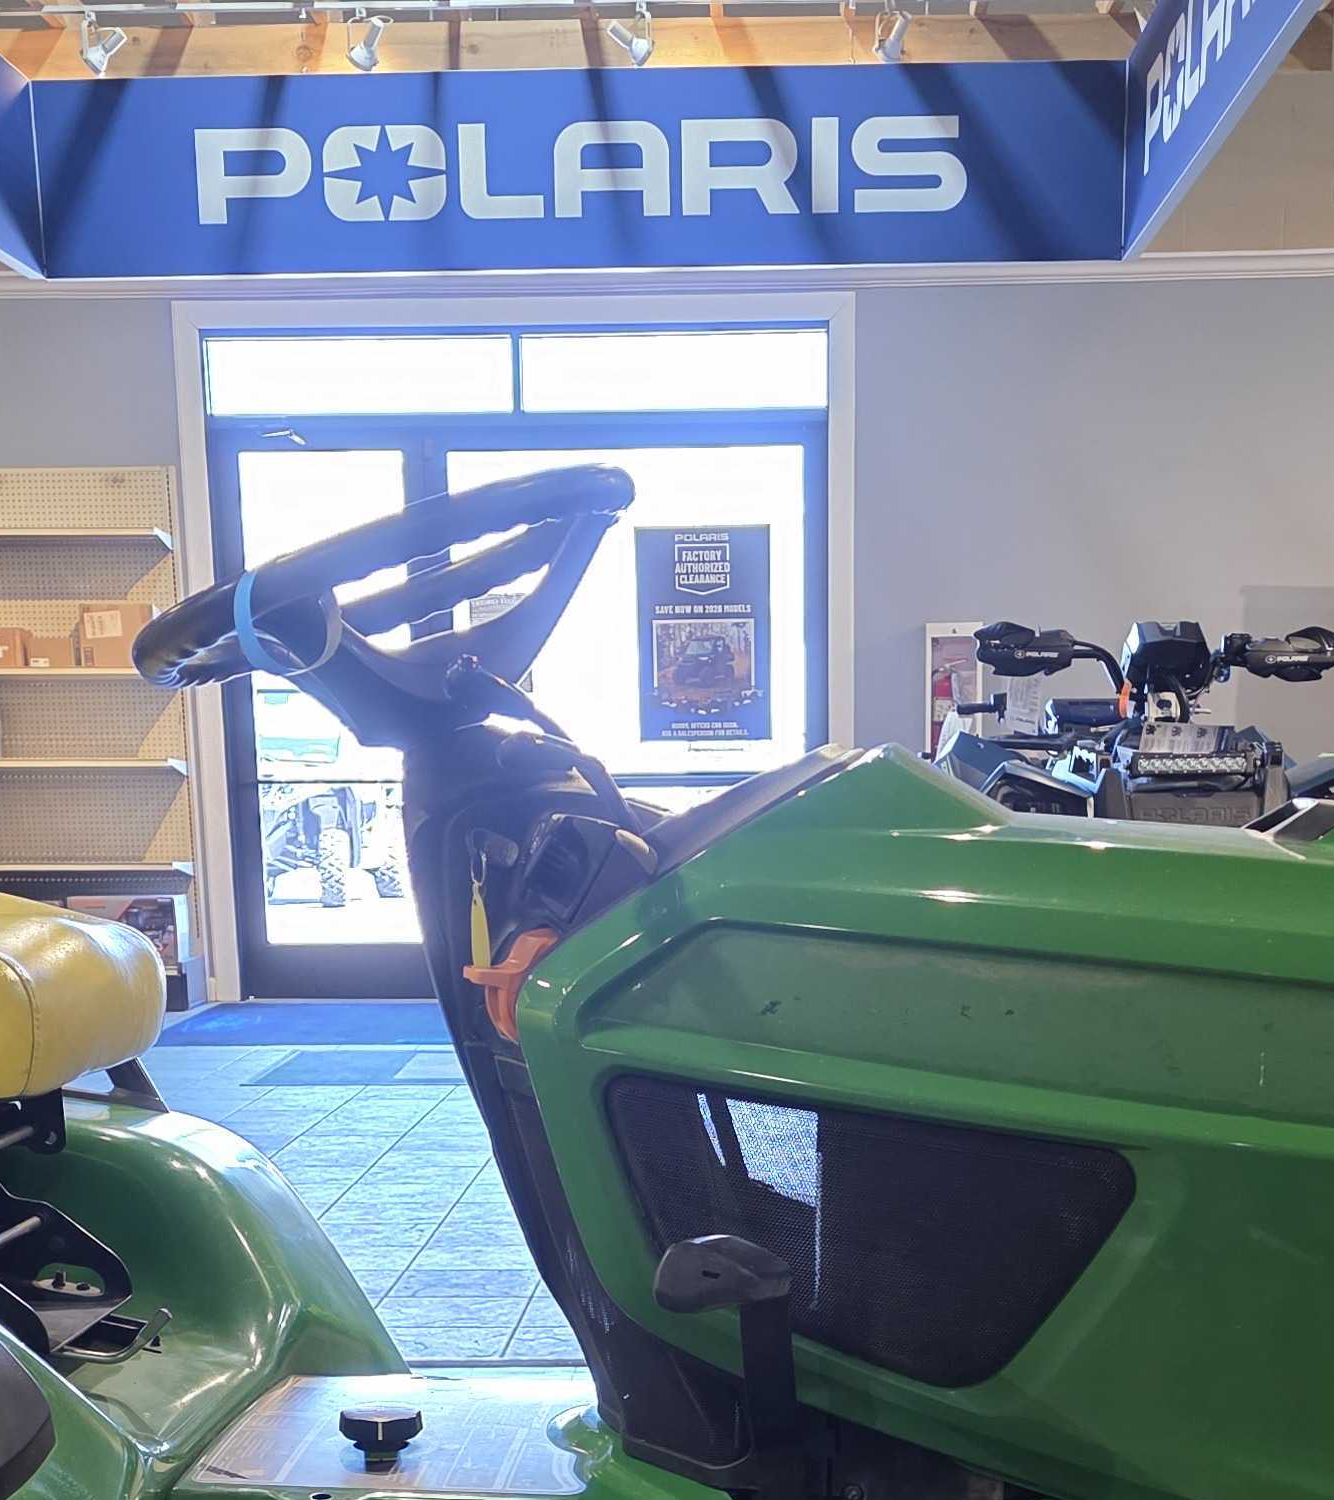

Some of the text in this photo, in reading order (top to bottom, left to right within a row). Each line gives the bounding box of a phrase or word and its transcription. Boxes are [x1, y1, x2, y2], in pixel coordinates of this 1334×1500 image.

[1143, 0, 1257, 177] POLA
[193, 115, 968, 225] POLARIS
[675, 532, 729, 541] POLARIS
[682, 550, 722, 561] FACTORY
[675, 562, 730, 573] AUTHORIZED
[680, 574, 726, 584] CLEARANCE
